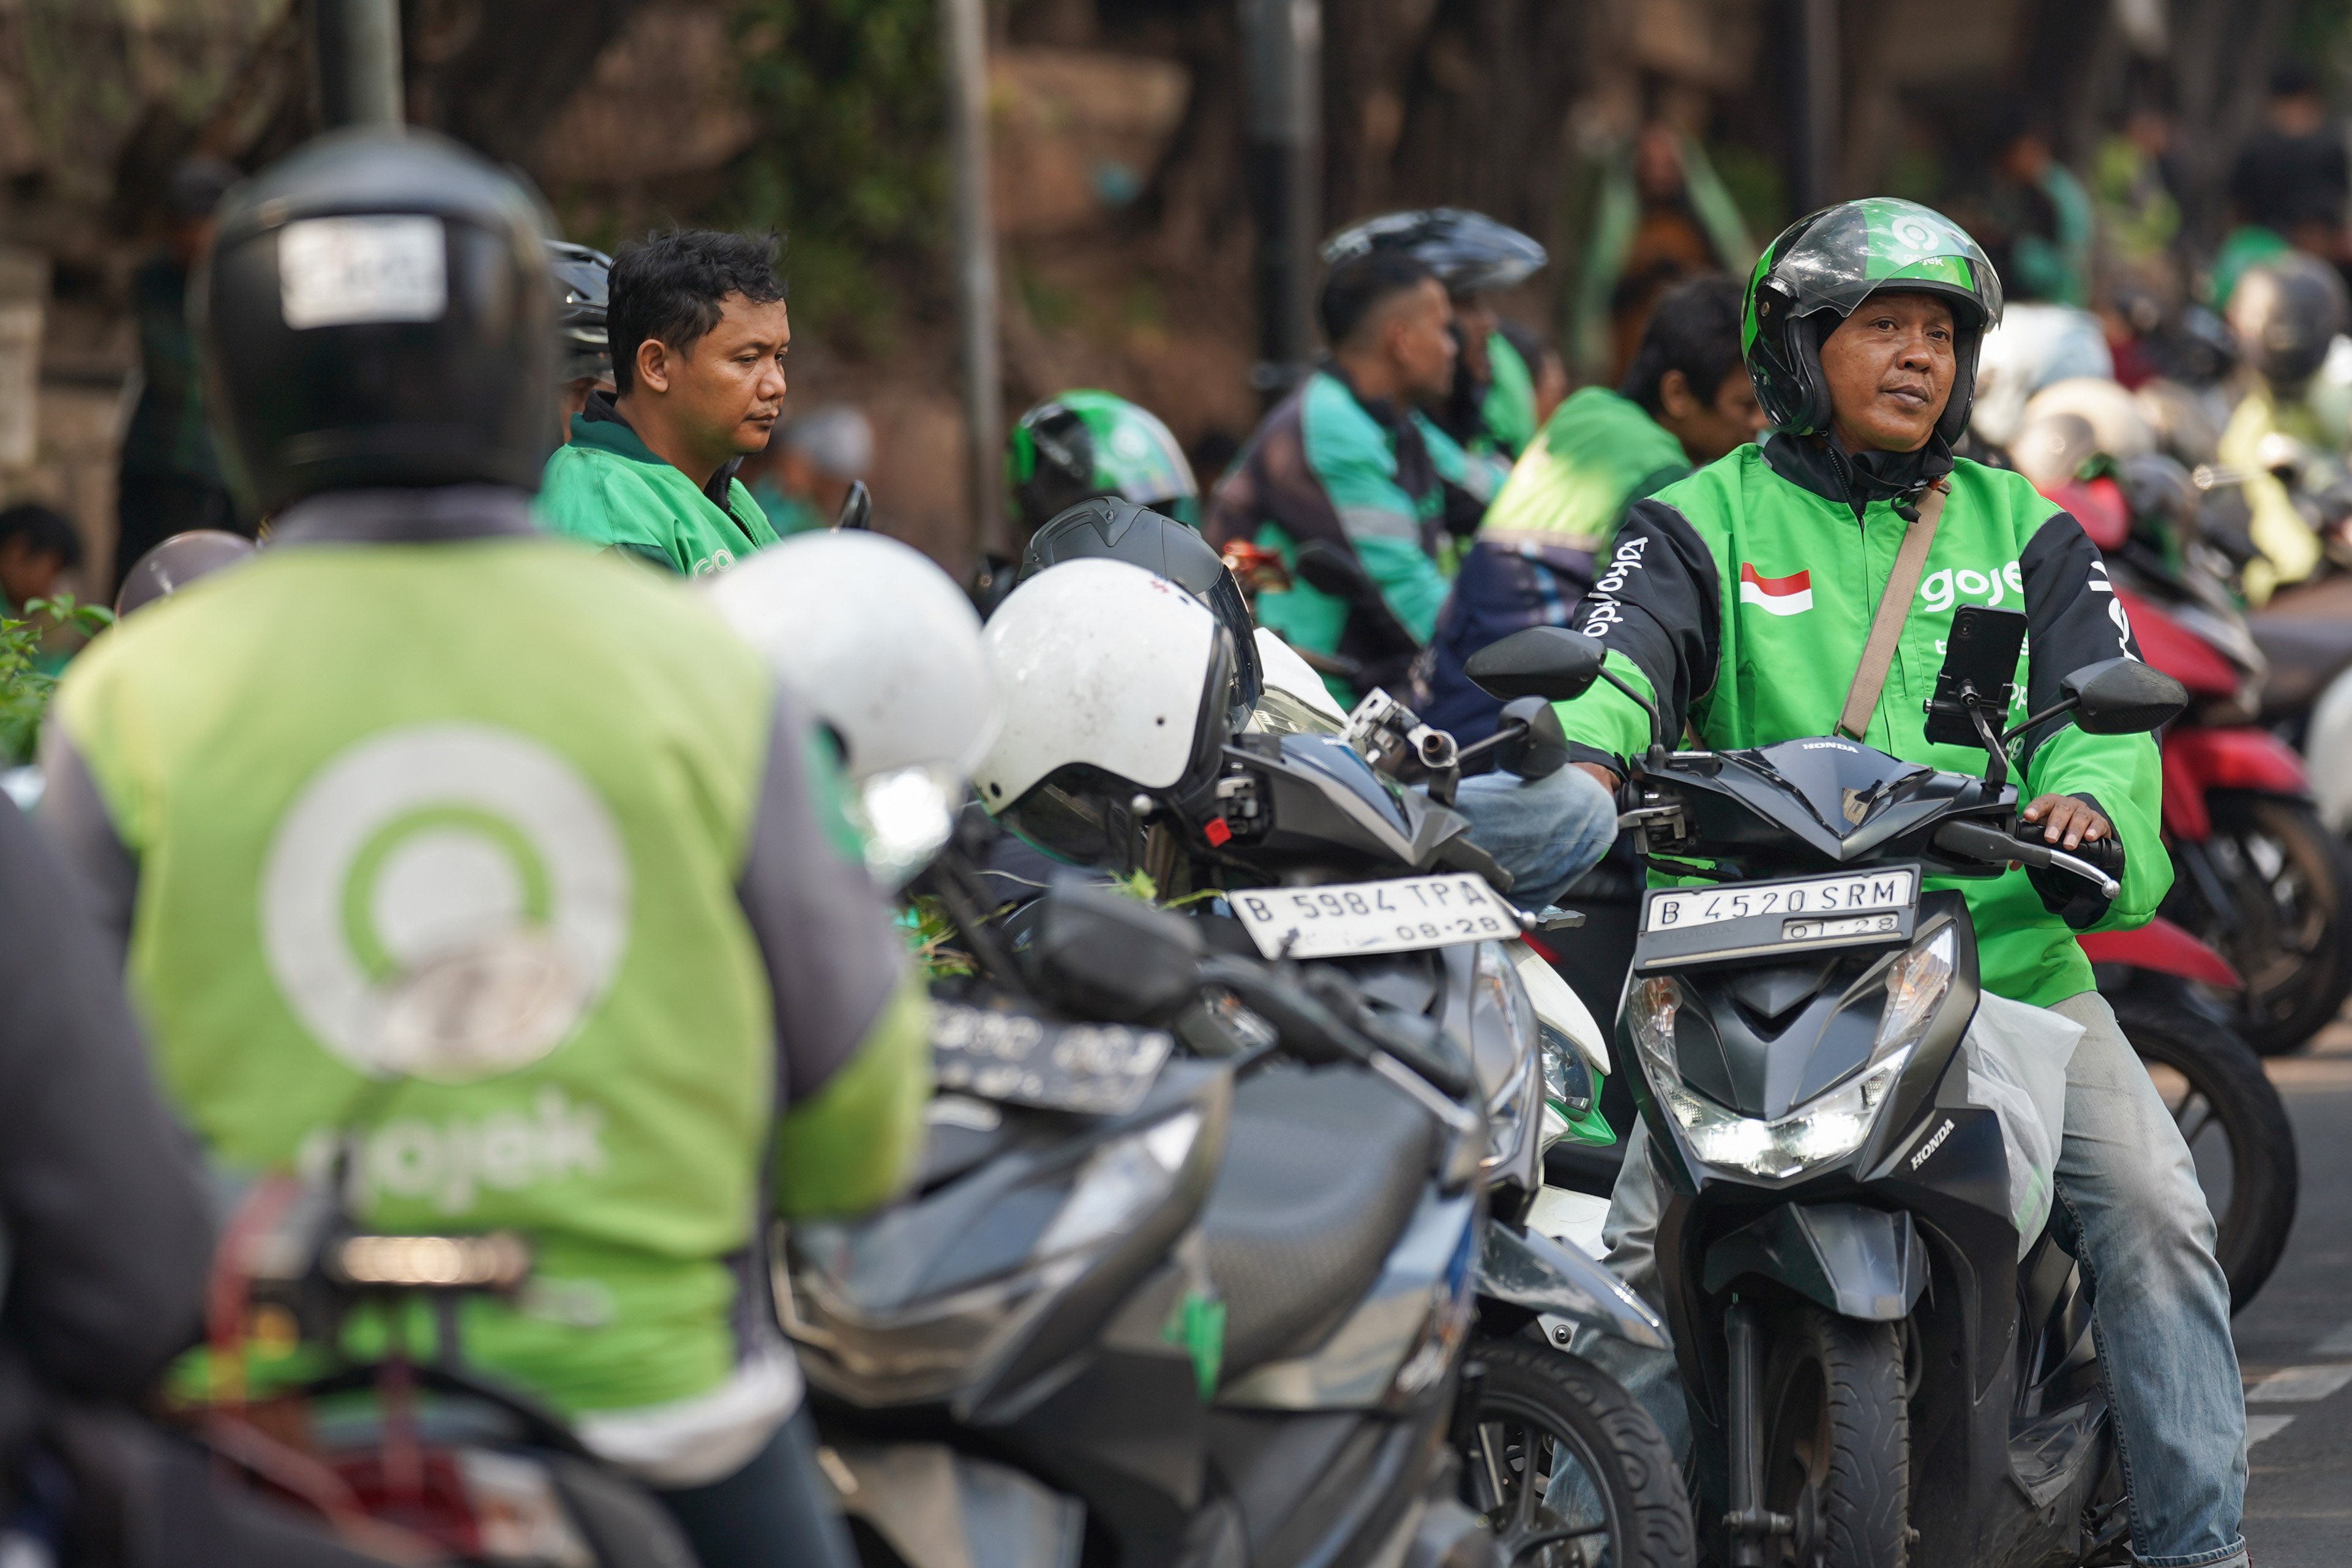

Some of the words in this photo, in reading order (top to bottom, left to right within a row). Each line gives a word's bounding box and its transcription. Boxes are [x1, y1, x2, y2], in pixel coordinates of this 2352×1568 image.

[1920, 561, 2024, 612] goje
[1802, 742, 1859, 753] HONDA
[1243, 898, 1273, 922] B
[1292, 889, 1396, 919] 5984
[1406, 881, 1487, 906] TPA
[1661, 901, 1679, 925] B
[1705, 890, 1805, 919] 4520
[1821, 880, 1894, 909] SRM
[1911, 1119, 1955, 1171] HONDA
